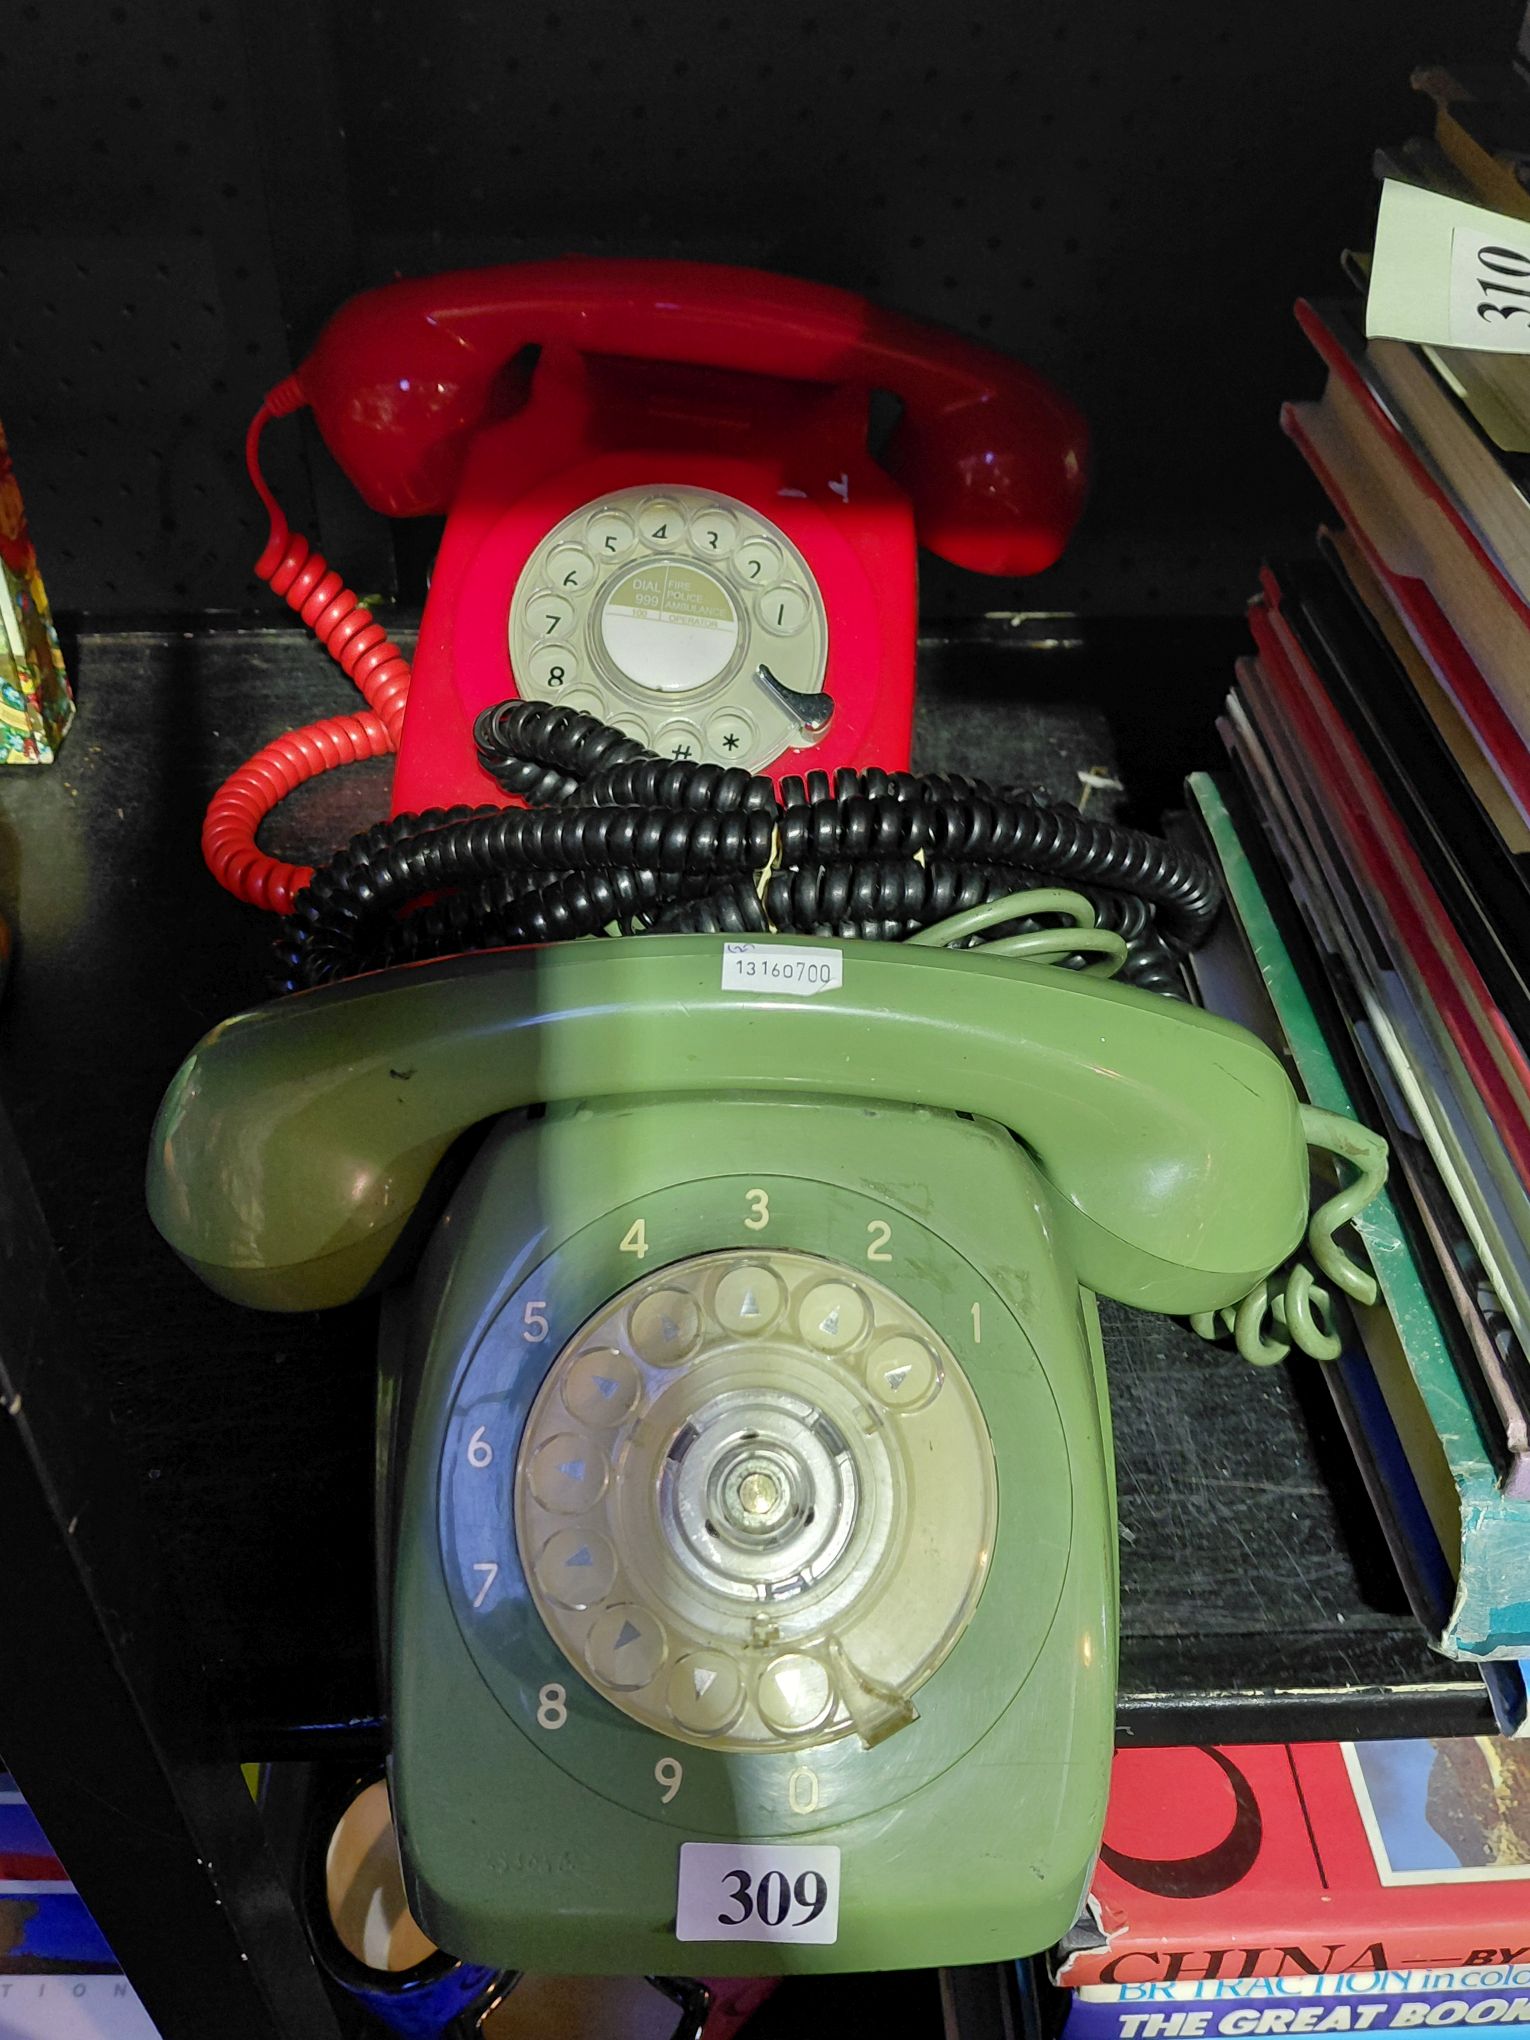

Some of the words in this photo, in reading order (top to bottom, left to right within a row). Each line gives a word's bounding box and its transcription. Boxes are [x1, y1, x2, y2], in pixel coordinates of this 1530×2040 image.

[1476, 246, 1530, 328] 310
[652, 524, 667, 539] 4
[632, 579, 661, 593] DIAL
[635, 594, 659, 607] 999
[666, 591, 704, 603] POLICE
[668, 580, 691, 591] FIRE
[545, 614, 561, 634] 7
[664, 601, 727, 617] AMBULANCE
[668, 615, 718, 627] OPERATOR
[777, 603, 784, 626] 1
[547, 666, 565, 687] 8
[736, 960, 831, 983] 13160700
[744, 1188, 769, 1230] 3
[619, 1219, 649, 1258] 4
[866, 1220, 893, 1262] 2
[522, 1301, 549, 1342] 5
[970, 1302, 982, 1343] 1
[466, 1425, 493, 1468] 6
[472, 1563, 498, 1608] 7
[537, 1683, 568, 1729] 8
[654, 1757, 682, 1804] 9
[788, 1766, 820, 1815] 0
[717, 1869, 828, 1927] 309
[1099, 1942, 1389, 1984] CHINA
[1421, 1968, 1455, 1989] in
[1119, 2011, 1214, 2039] THE
[1217, 2003, 1389, 2036] GREAT
